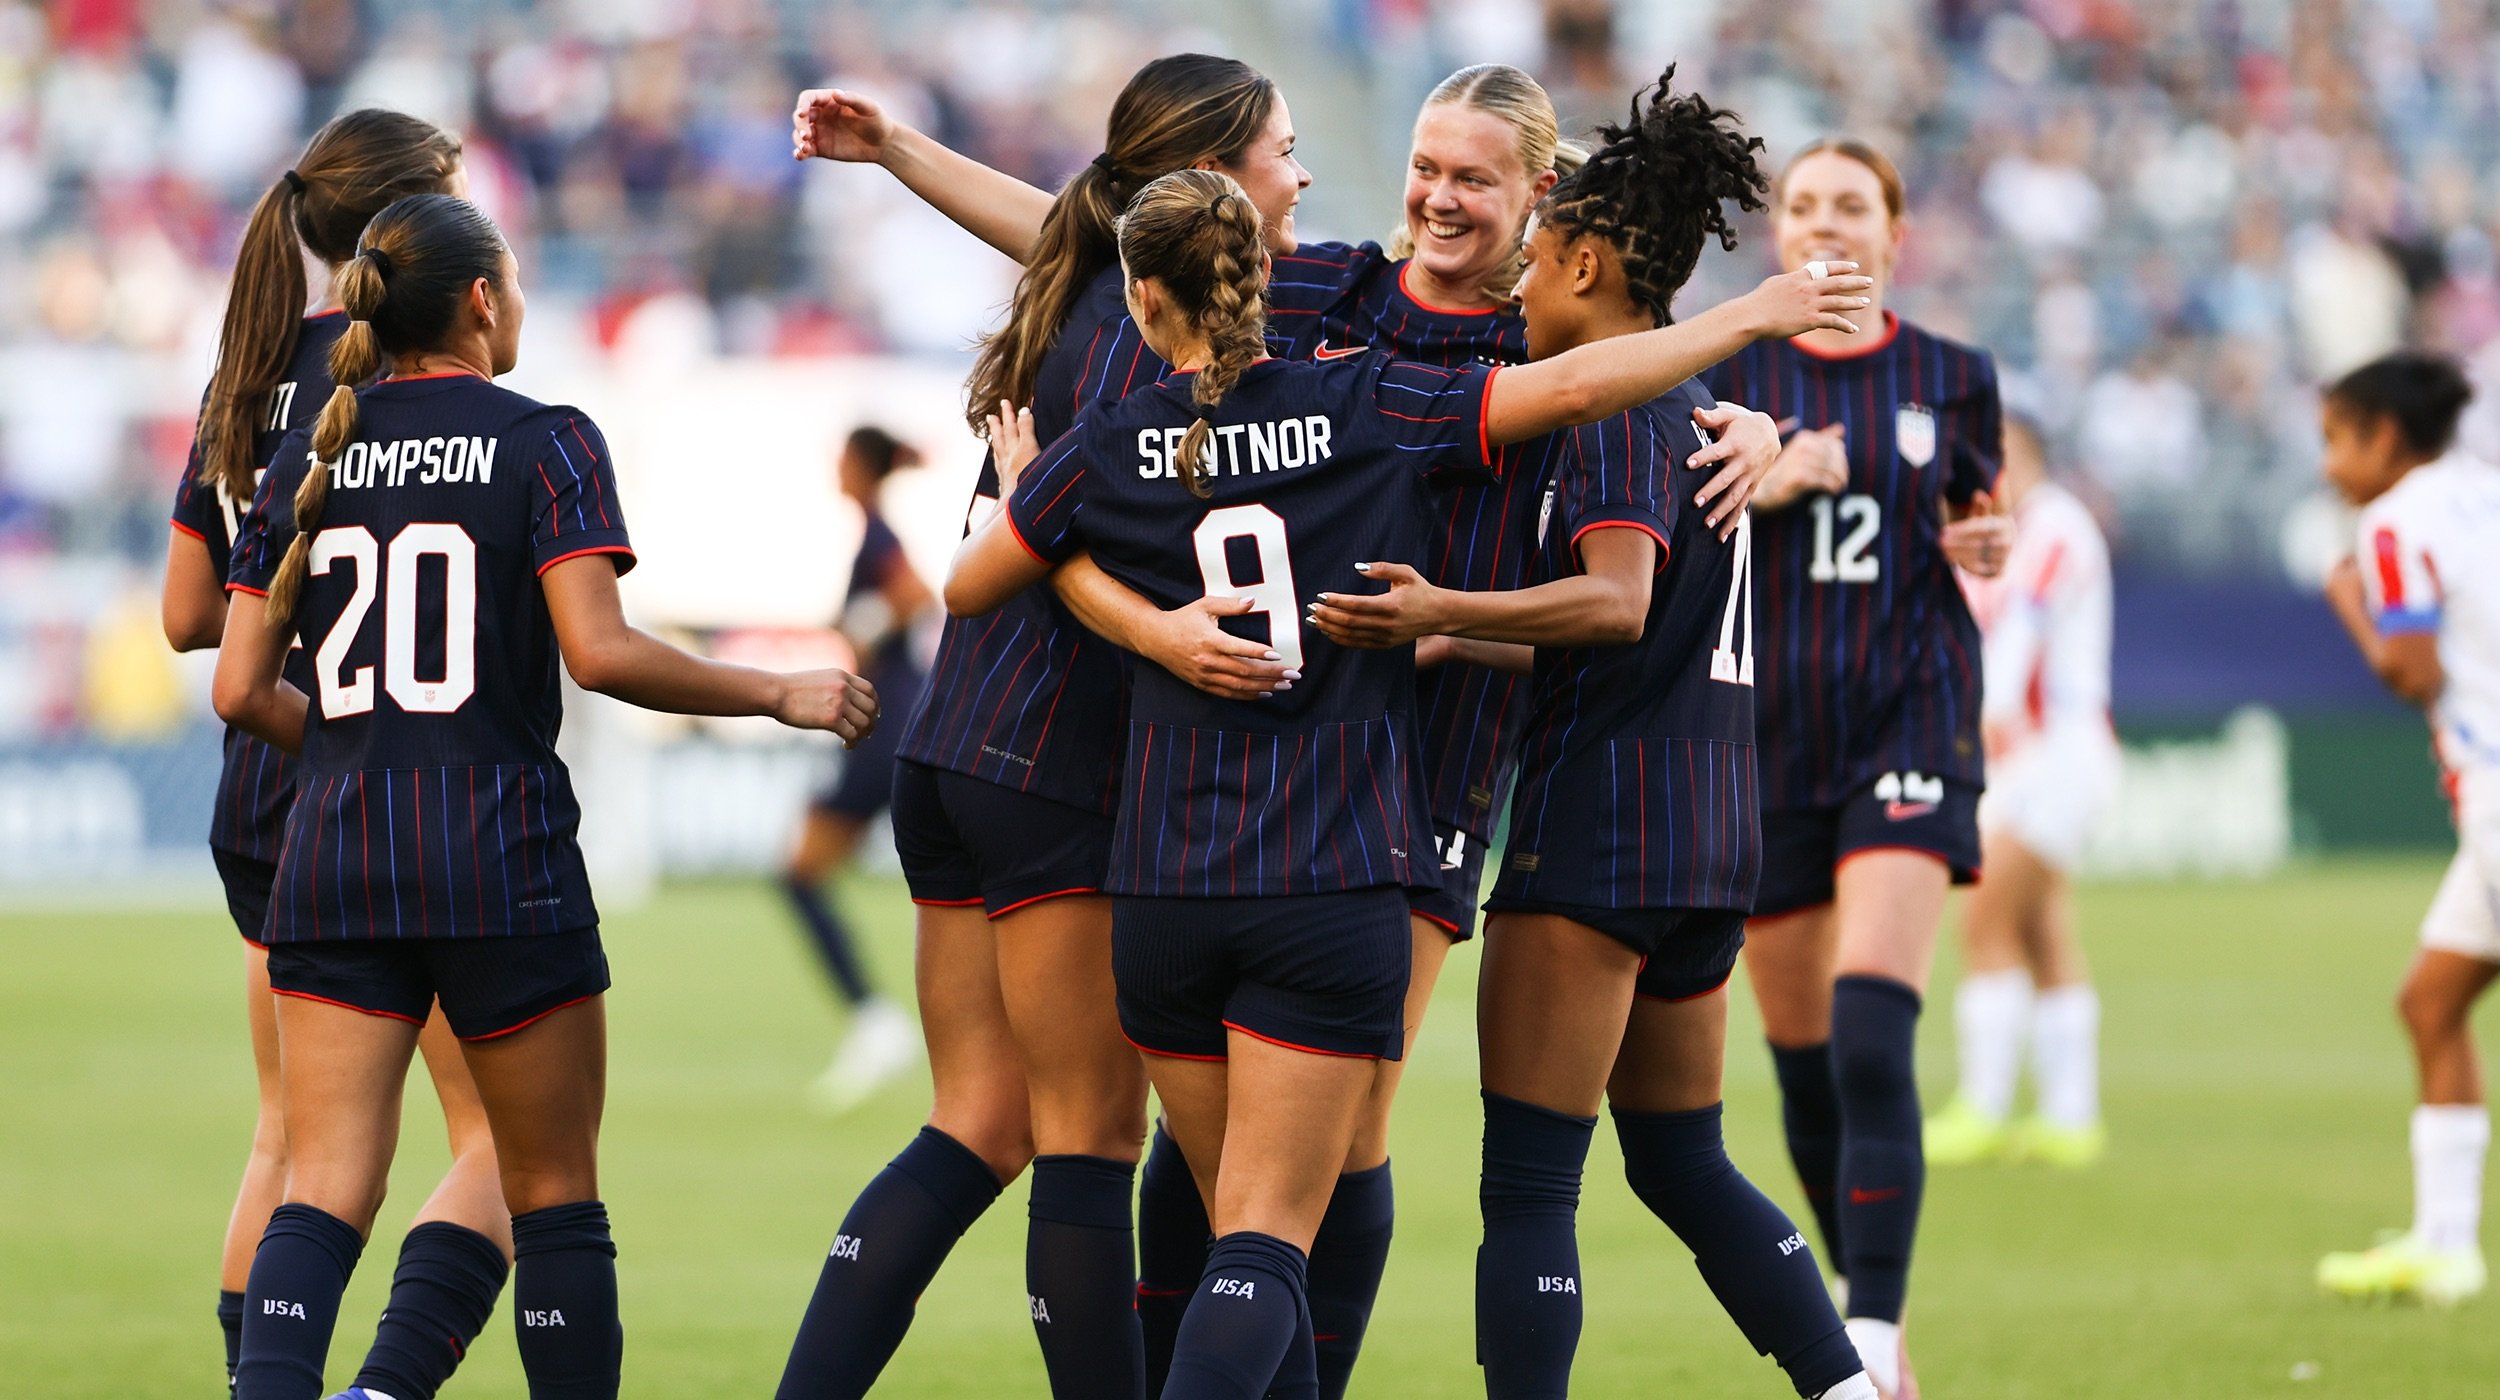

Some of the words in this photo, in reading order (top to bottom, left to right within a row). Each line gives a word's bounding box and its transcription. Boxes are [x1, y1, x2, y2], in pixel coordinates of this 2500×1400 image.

[1808, 494, 1881, 582] 12
[1193, 502, 1303, 682] 9
[308, 522, 476, 721] 20
[830, 1234, 862, 1261] USA
[1776, 1231, 1808, 1256] USA
[1211, 1277, 1256, 1300] USA
[1536, 1275, 1578, 1295] USA
[262, 1298, 307, 1321] USA
[523, 1308, 566, 1328] USA
